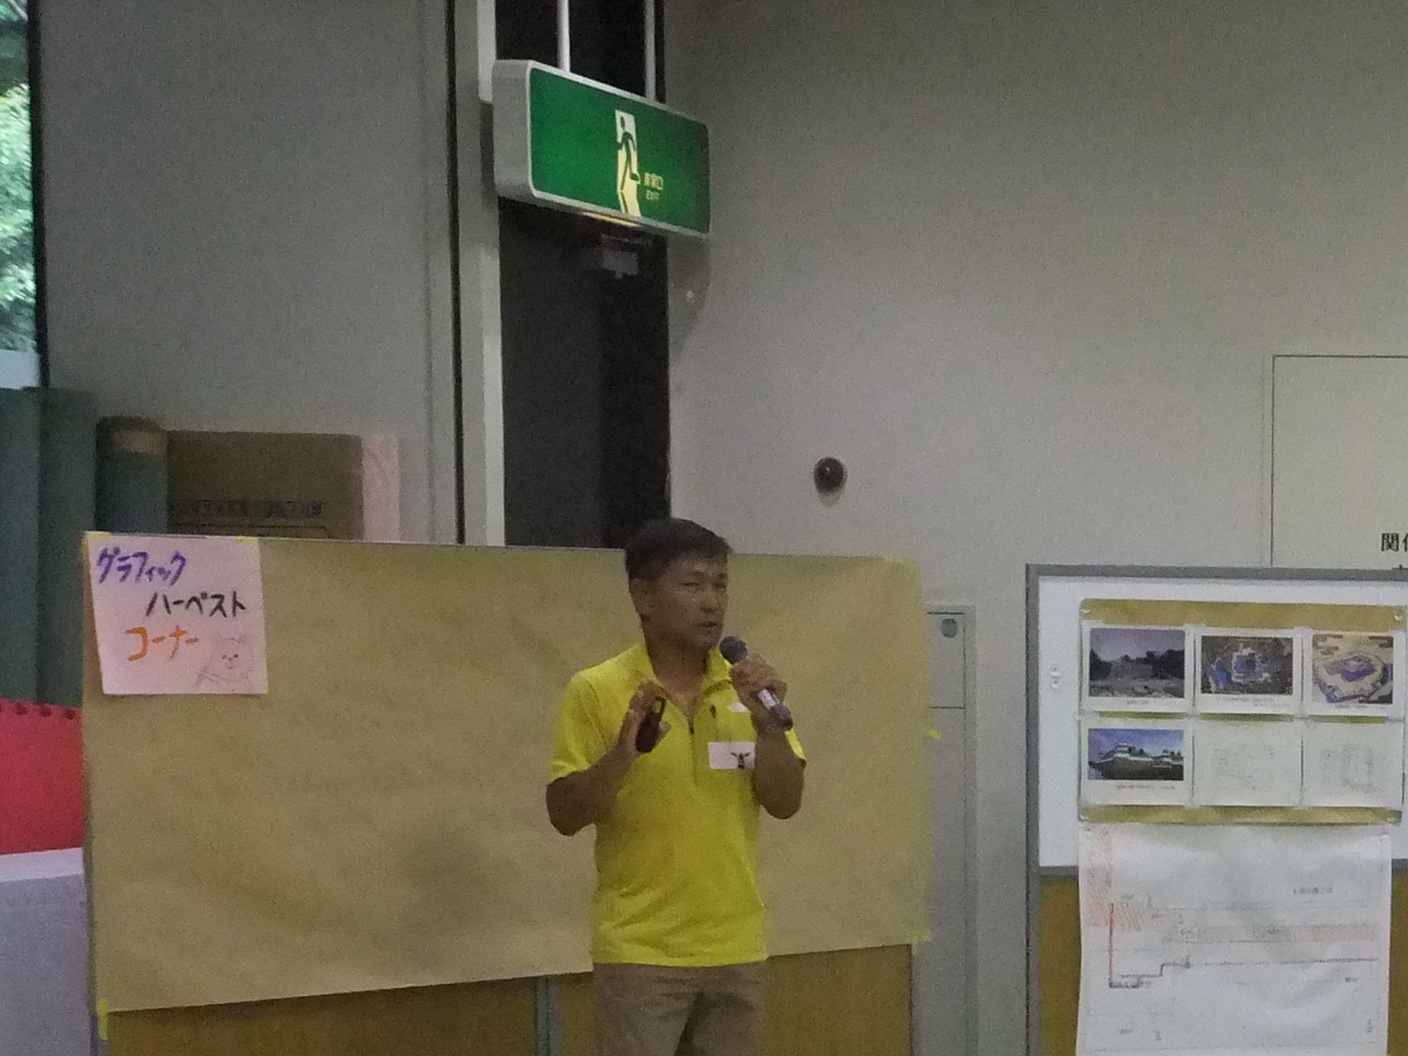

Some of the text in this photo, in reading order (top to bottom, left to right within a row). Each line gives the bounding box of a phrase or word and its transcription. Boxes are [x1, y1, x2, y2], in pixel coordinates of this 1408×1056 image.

[96, 546, 187, 586] グラフィック
[145, 590, 246, 619] ハーベスト
[125, 624, 199, 662] コーナー
